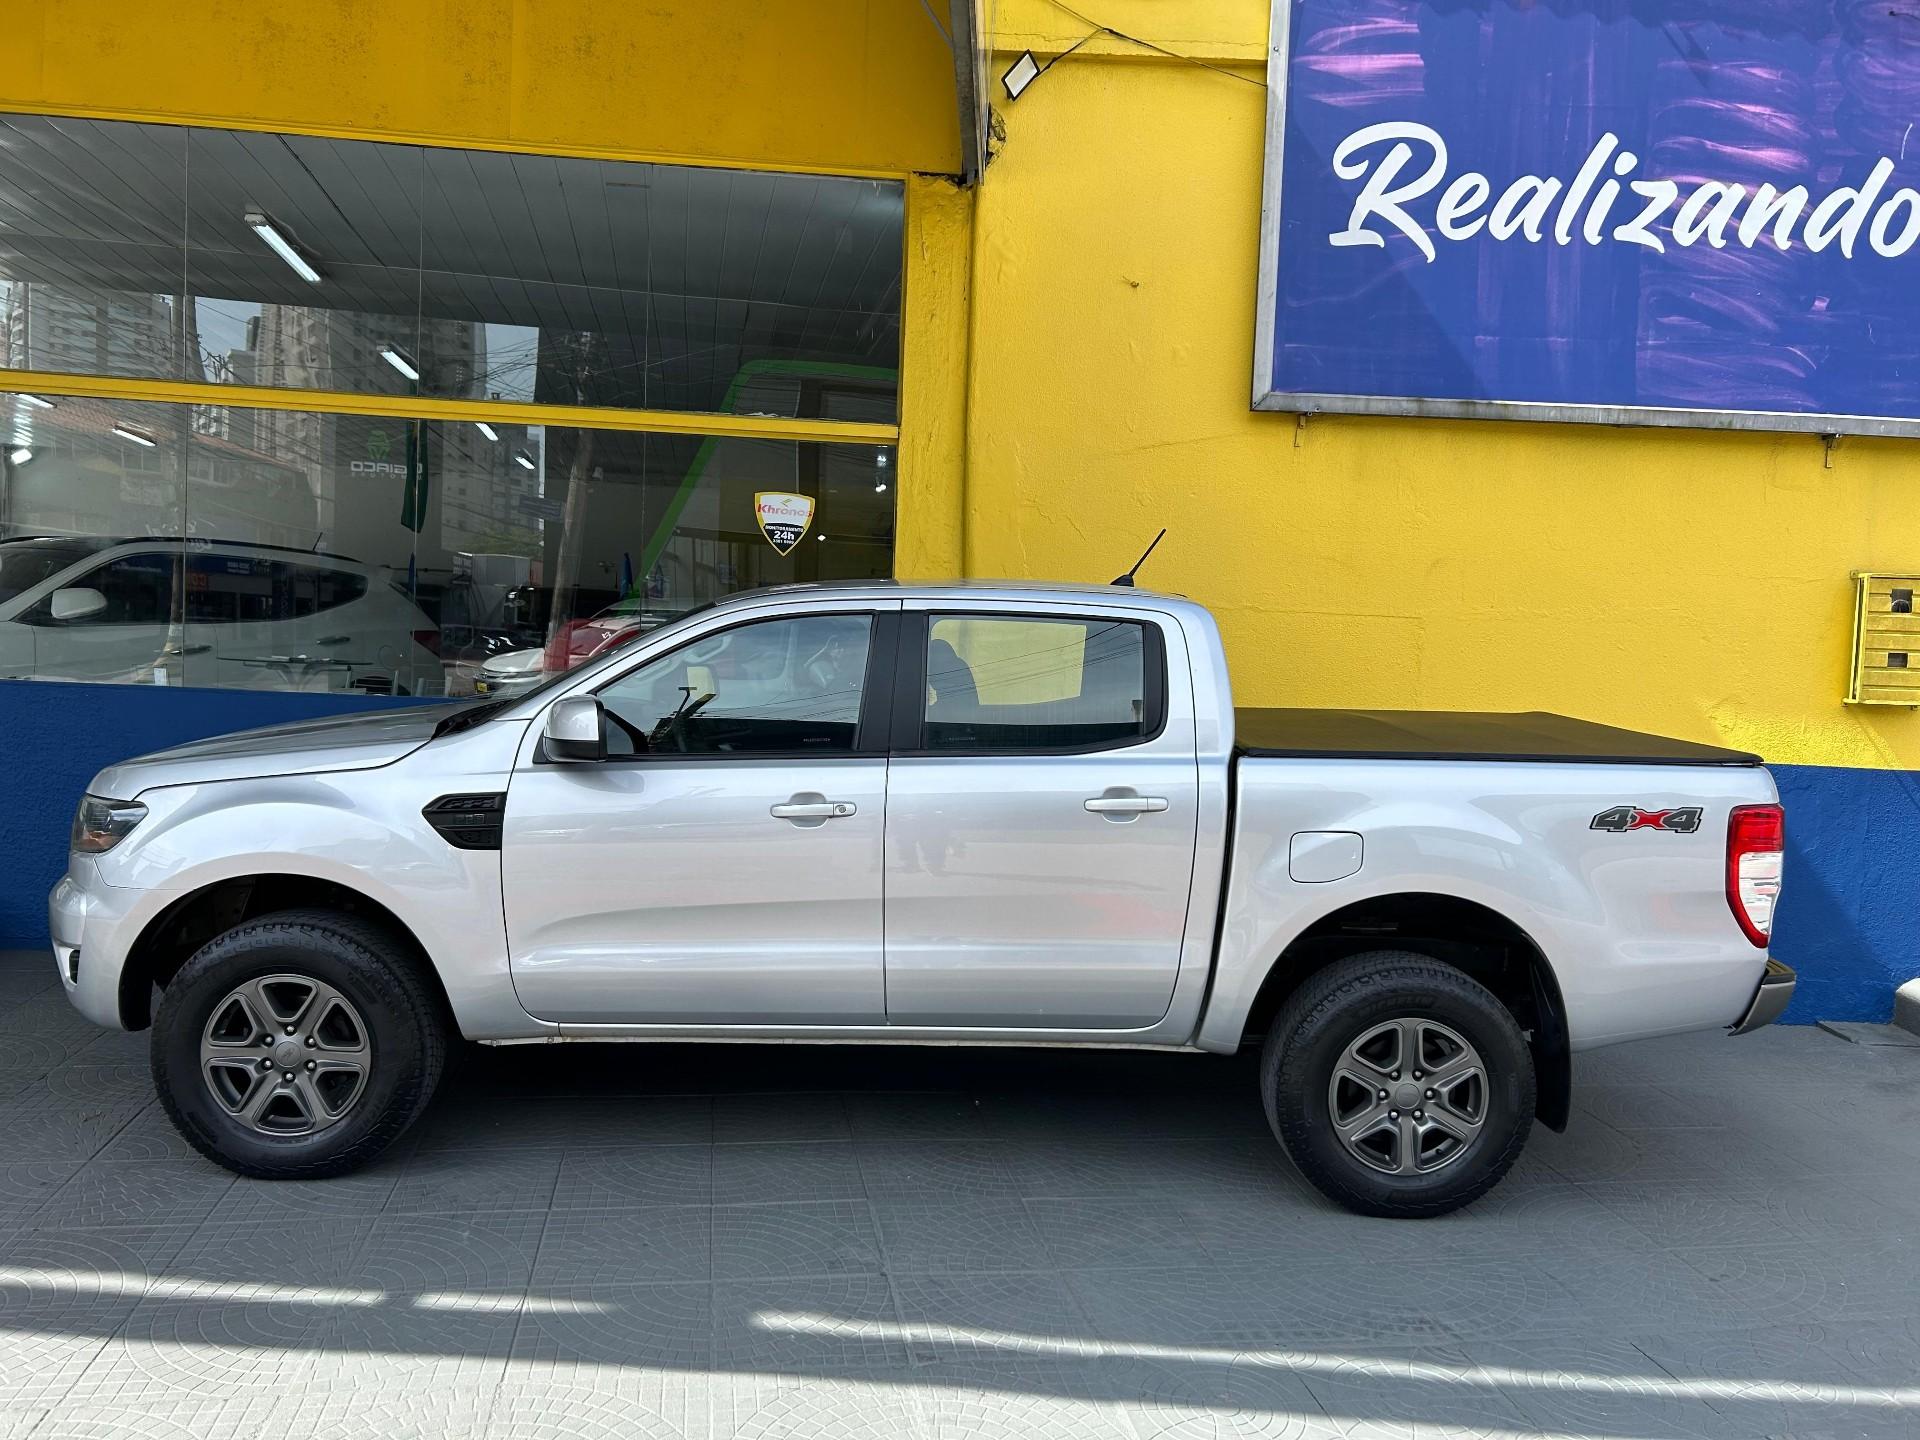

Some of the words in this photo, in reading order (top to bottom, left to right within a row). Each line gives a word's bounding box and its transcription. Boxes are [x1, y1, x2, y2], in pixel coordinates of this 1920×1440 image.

[1329, 120, 1920, 263] Realizando
[757, 504, 812, 517] Khronos
[774, 531, 795, 539] 24h
